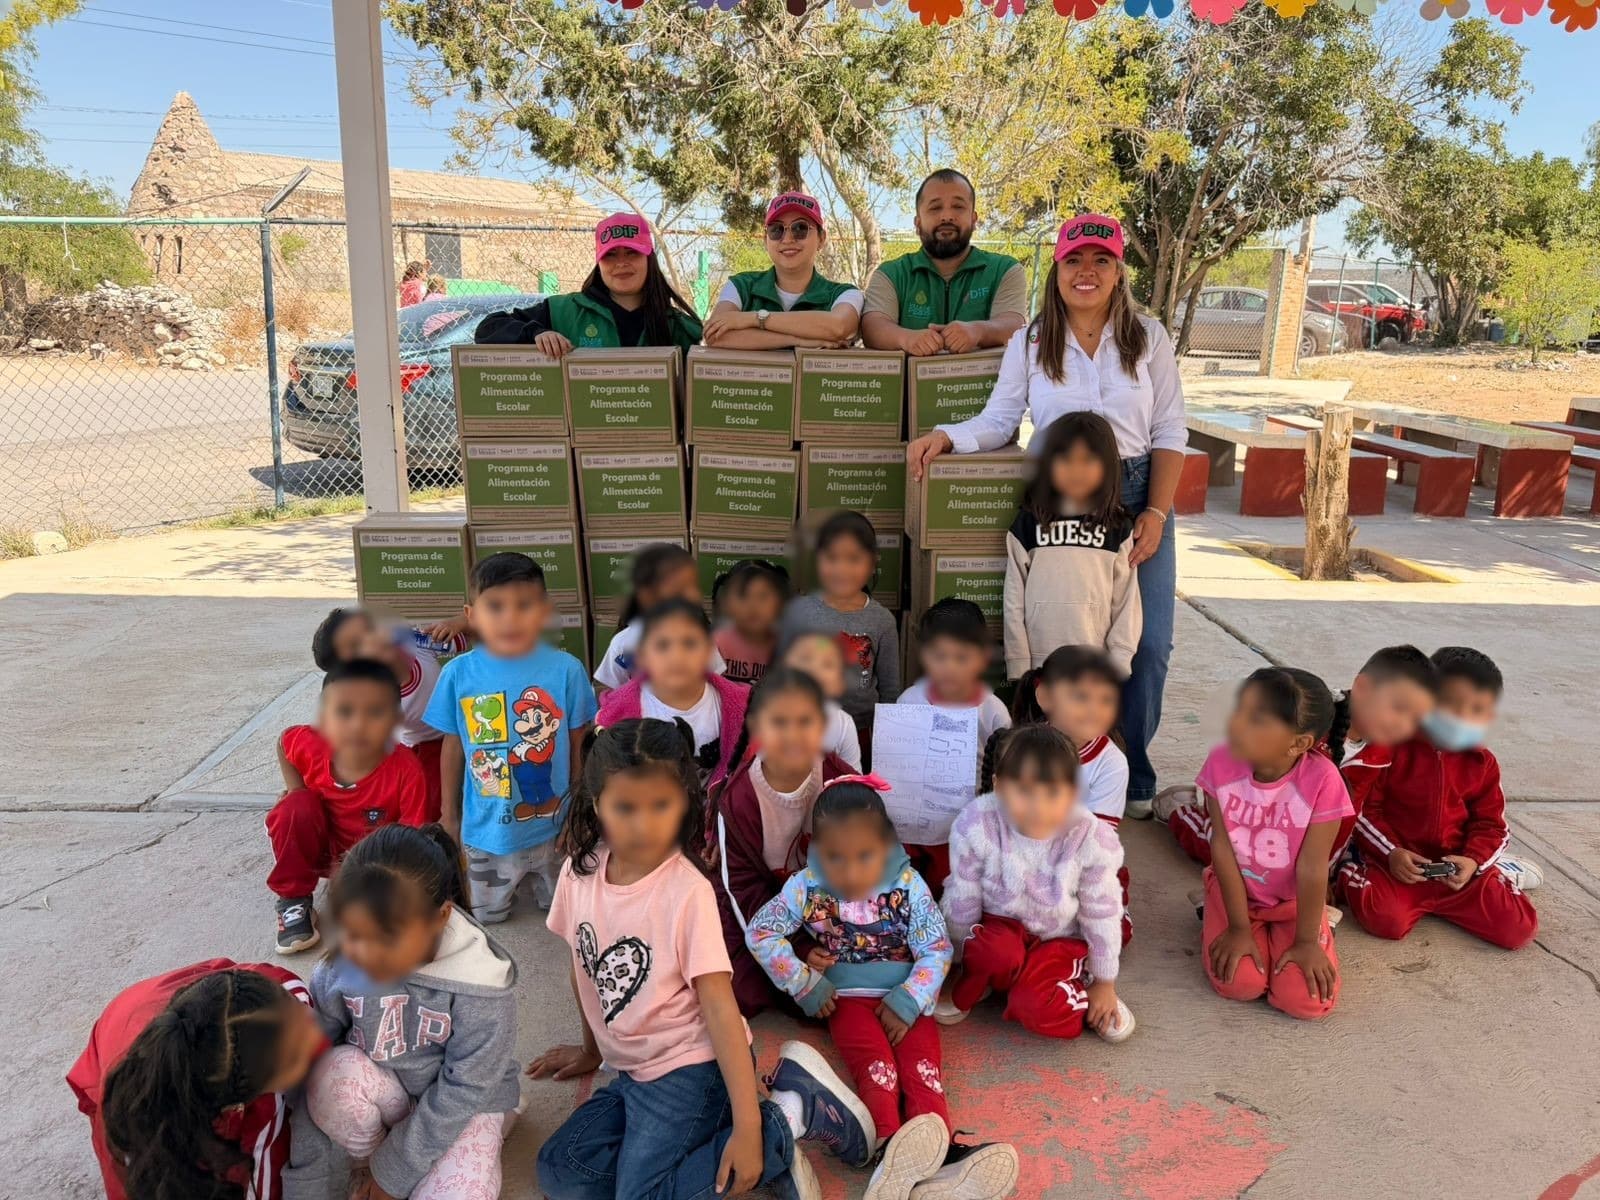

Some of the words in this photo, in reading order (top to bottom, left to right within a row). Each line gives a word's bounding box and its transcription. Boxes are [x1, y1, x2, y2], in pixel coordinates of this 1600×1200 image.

[480, 371, 527, 383] Programa
[530, 372, 542, 381] de
[821, 378, 867, 389] Programa
[869, 379, 881, 388] de
[937, 383, 983, 393] Programa
[480, 387, 544, 396] Alimentación
[590, 384, 635, 394] Programa
[639, 384, 650, 393] de
[713, 384, 758, 397] Programa
[761, 387, 773, 397] de
[820, 393, 882, 404] Alimentación
[936, 395, 986, 407] Alimentaci
[496, 402, 530, 411] Escolar
[590, 399, 652, 409] Alimentación
[711, 400, 773, 412] Alimentación
[833, 408, 867, 418] Escolar
[605, 414, 639, 423] Escolar
[725, 415, 759, 425] Escolar
[488, 464, 535, 474] Programa
[537, 463, 548, 472] de
[602, 473, 647, 483] Programa
[649, 472, 661, 480] de
[828, 468, 873, 480] Programa
[875, 468, 887, 477] de
[488, 477, 550, 487] Alimentación
[717, 474, 762, 484] Programa
[764, 476, 776, 485] de
[602, 487, 663, 496] Alimentación
[826, 481, 887, 492] Alimentación
[949, 484, 997, 495] Programa
[1000, 484, 1013, 494] de
[503, 492, 537, 501] Escolar
[715, 487, 776, 499] Alimentación
[617, 501, 650, 509] Escolar
[840, 496, 873, 505] Escolar
[947, 499, 1013, 509] Alimentación
[728, 502, 761, 512] Escolar
[962, 515, 998, 525] Escolar
[1036, 520, 1107, 547] GUESS
[381, 552, 428, 562] Programa
[431, 551, 443, 561] de
[381, 565, 445, 575] Alimentación
[397, 580, 431, 589] Escolar
[954, 592, 1004, 601] Alimentac
[725, 659, 748, 677] THIS
[1223, 793, 1295, 827] PUMA
